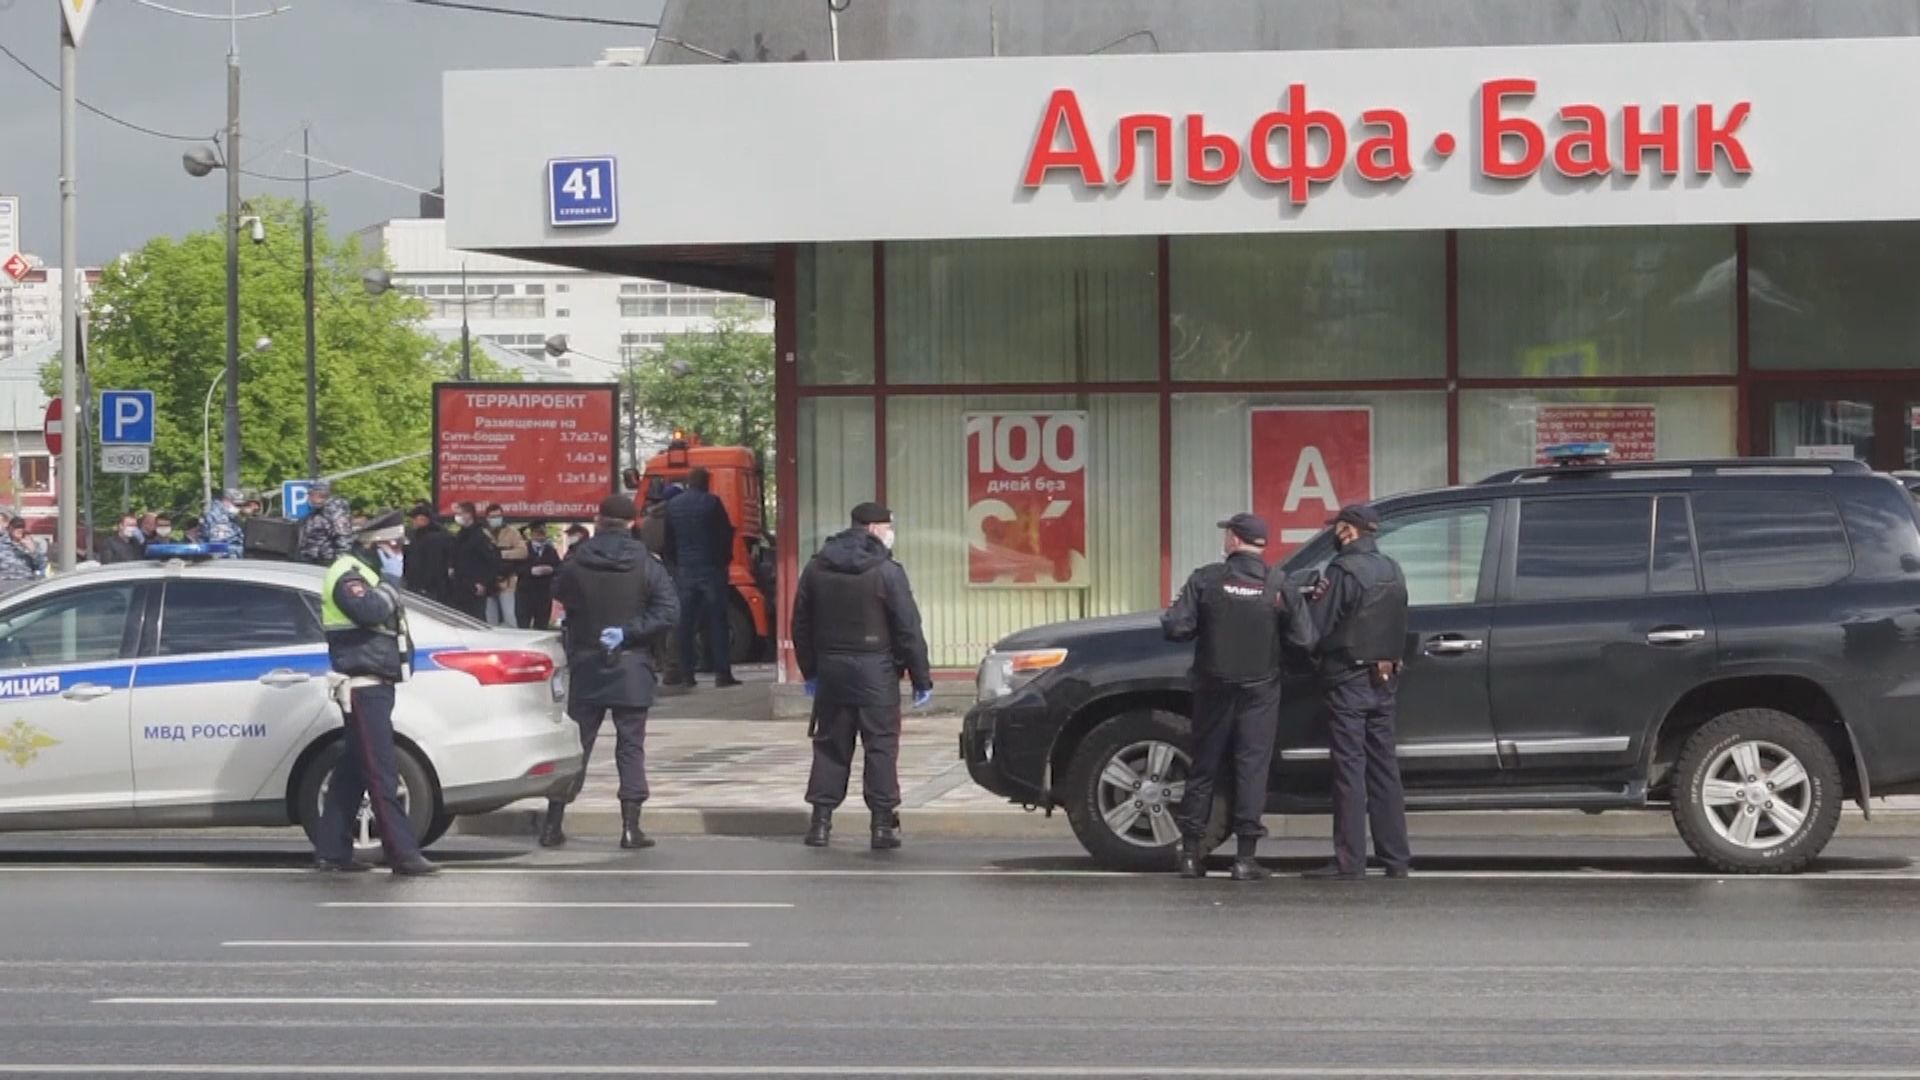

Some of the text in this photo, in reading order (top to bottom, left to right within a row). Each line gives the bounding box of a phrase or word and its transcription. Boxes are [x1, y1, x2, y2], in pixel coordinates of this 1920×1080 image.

[562, 168, 601, 199] 41
[464, 393, 587, 409] ТЕРРАПРОЕКТ
[115, 397, 144, 438] P
[475, 415, 577, 430] Размещение на
[967, 415, 1085, 473] 100
[987, 476, 1066, 493] дней без
[144, 723, 267, 742] МВД РОССИИ
